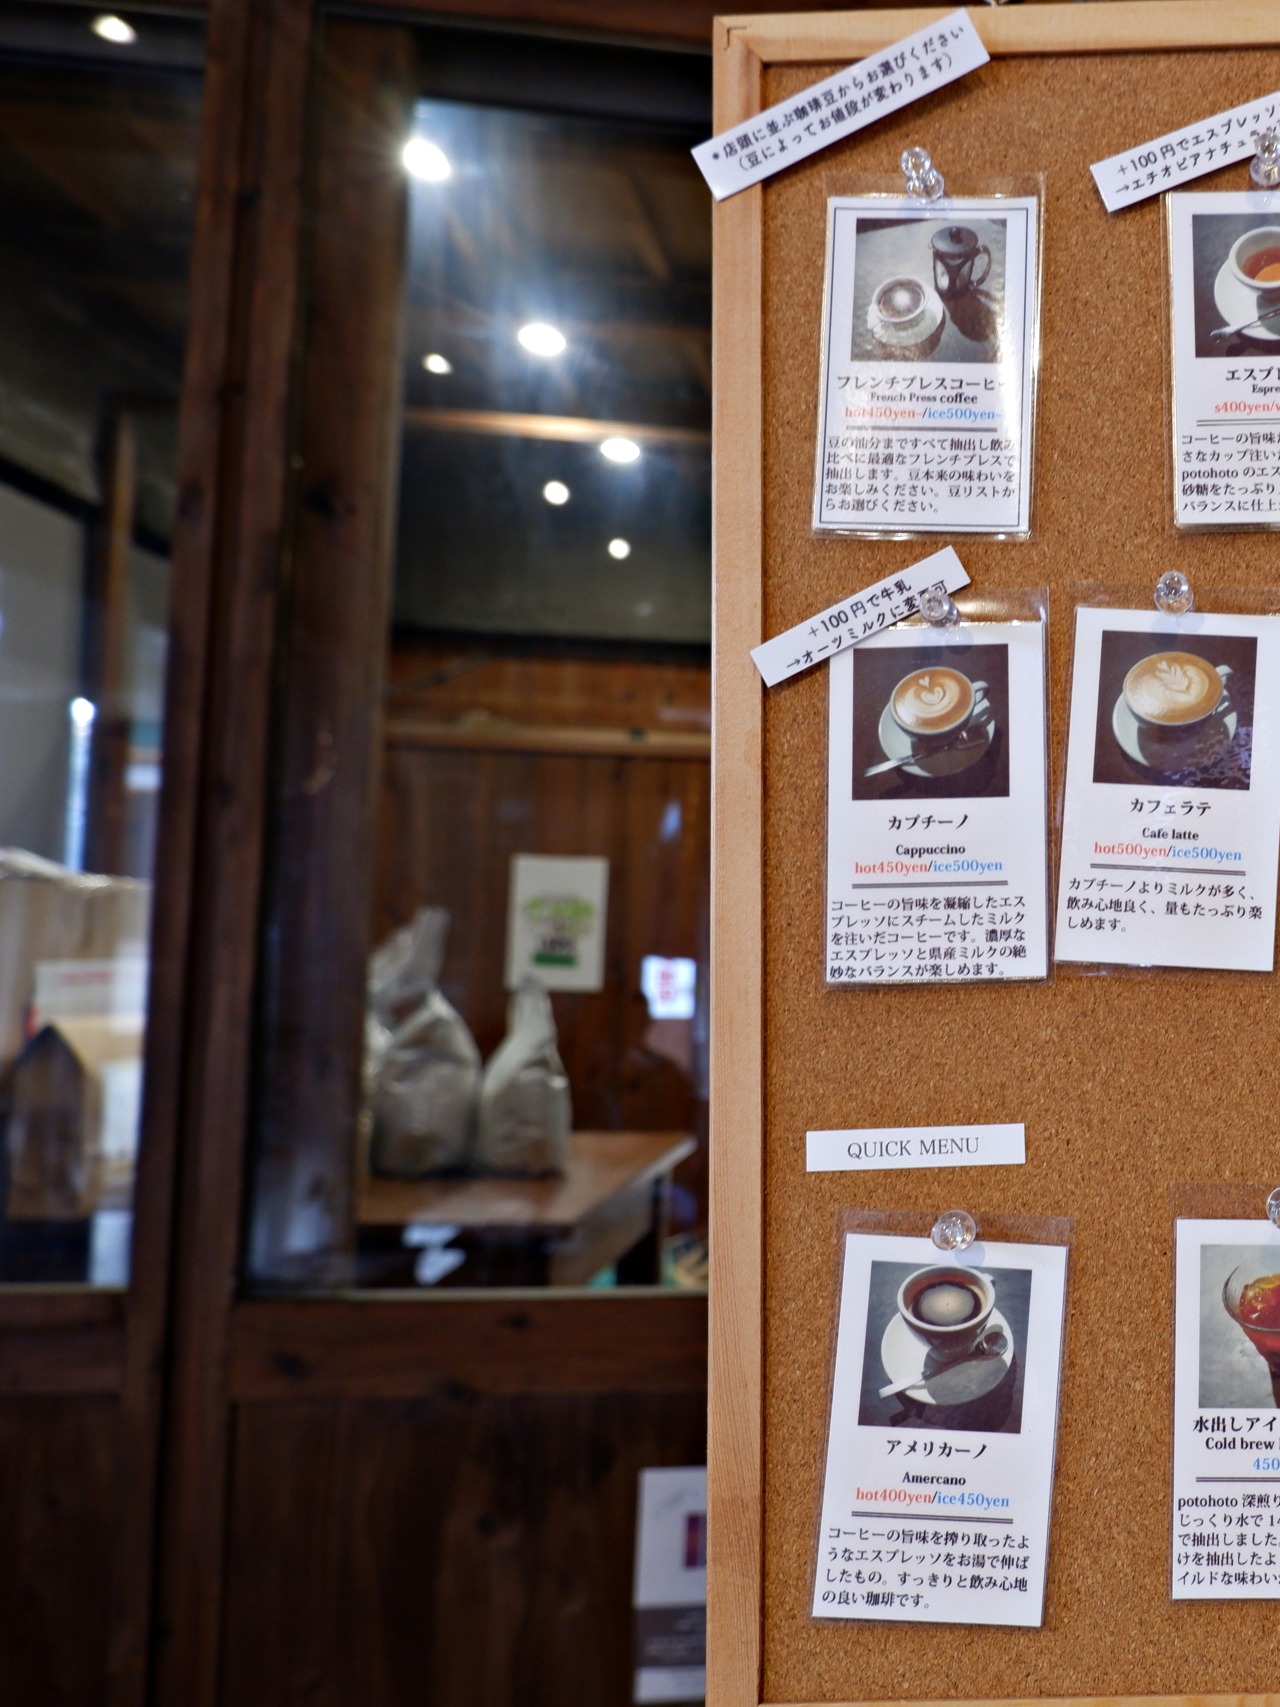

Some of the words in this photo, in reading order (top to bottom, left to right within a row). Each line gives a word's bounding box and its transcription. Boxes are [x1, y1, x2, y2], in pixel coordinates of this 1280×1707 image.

[838, 376, 1004, 391] フレンチプレスコーヒ
[870, 393, 906, 402] French
[909, 393, 937, 403] Press
[940, 393, 978, 404] coffee
[826, 499, 939, 512] らお選びください。
[803, 580, 947, 664] オーツミルクに変可
[1130, 798, 1211, 817] カフェラテ
[888, 814, 969, 830] カプチーノ
[1142, 828, 1168, 839] Cafe
[1172, 829, 1199, 840] latte
[896, 844, 965, 858] Cappuccino
[1069, 878, 1256, 900] カプチーノよりミルクが多く、
[831, 895, 1026, 911] コーヒーの旨味を凝縮したエス
[1067, 896, 1262, 920] 飲み心地良く、量もたっぷり楽
[831, 912, 1025, 928] プレッソにスチームしたミルク
[1068, 917, 1126, 932] しめます。
[831, 928, 1025, 945] を注いだコーヒーです。濃厚な
[831, 946, 1026, 961] エスプレッソと県産ミルクの絶
[830, 963, 1004, 979] 妙なバランスが楽しめます。
[847, 1140, 912, 1159] QUICK
[920, 1137, 980, 1155] MENU
[887, 1439, 988, 1459] アメリカーノ
[1206, 1438, 1236, 1450] Cold
[1240, 1438, 1274, 1450] brew
[902, 1472, 967, 1486] Amercano
[828, 1527, 1029, 1550] コーヒーの旨味を搾り取ったよ
[828, 1547, 1029, 1570] うなエスプレッソをお湯で伸ば
[826, 1568, 1028, 1592] したもの。すっきりと飲み心地
[822, 1590, 930, 1609] の良い珈琲です。
